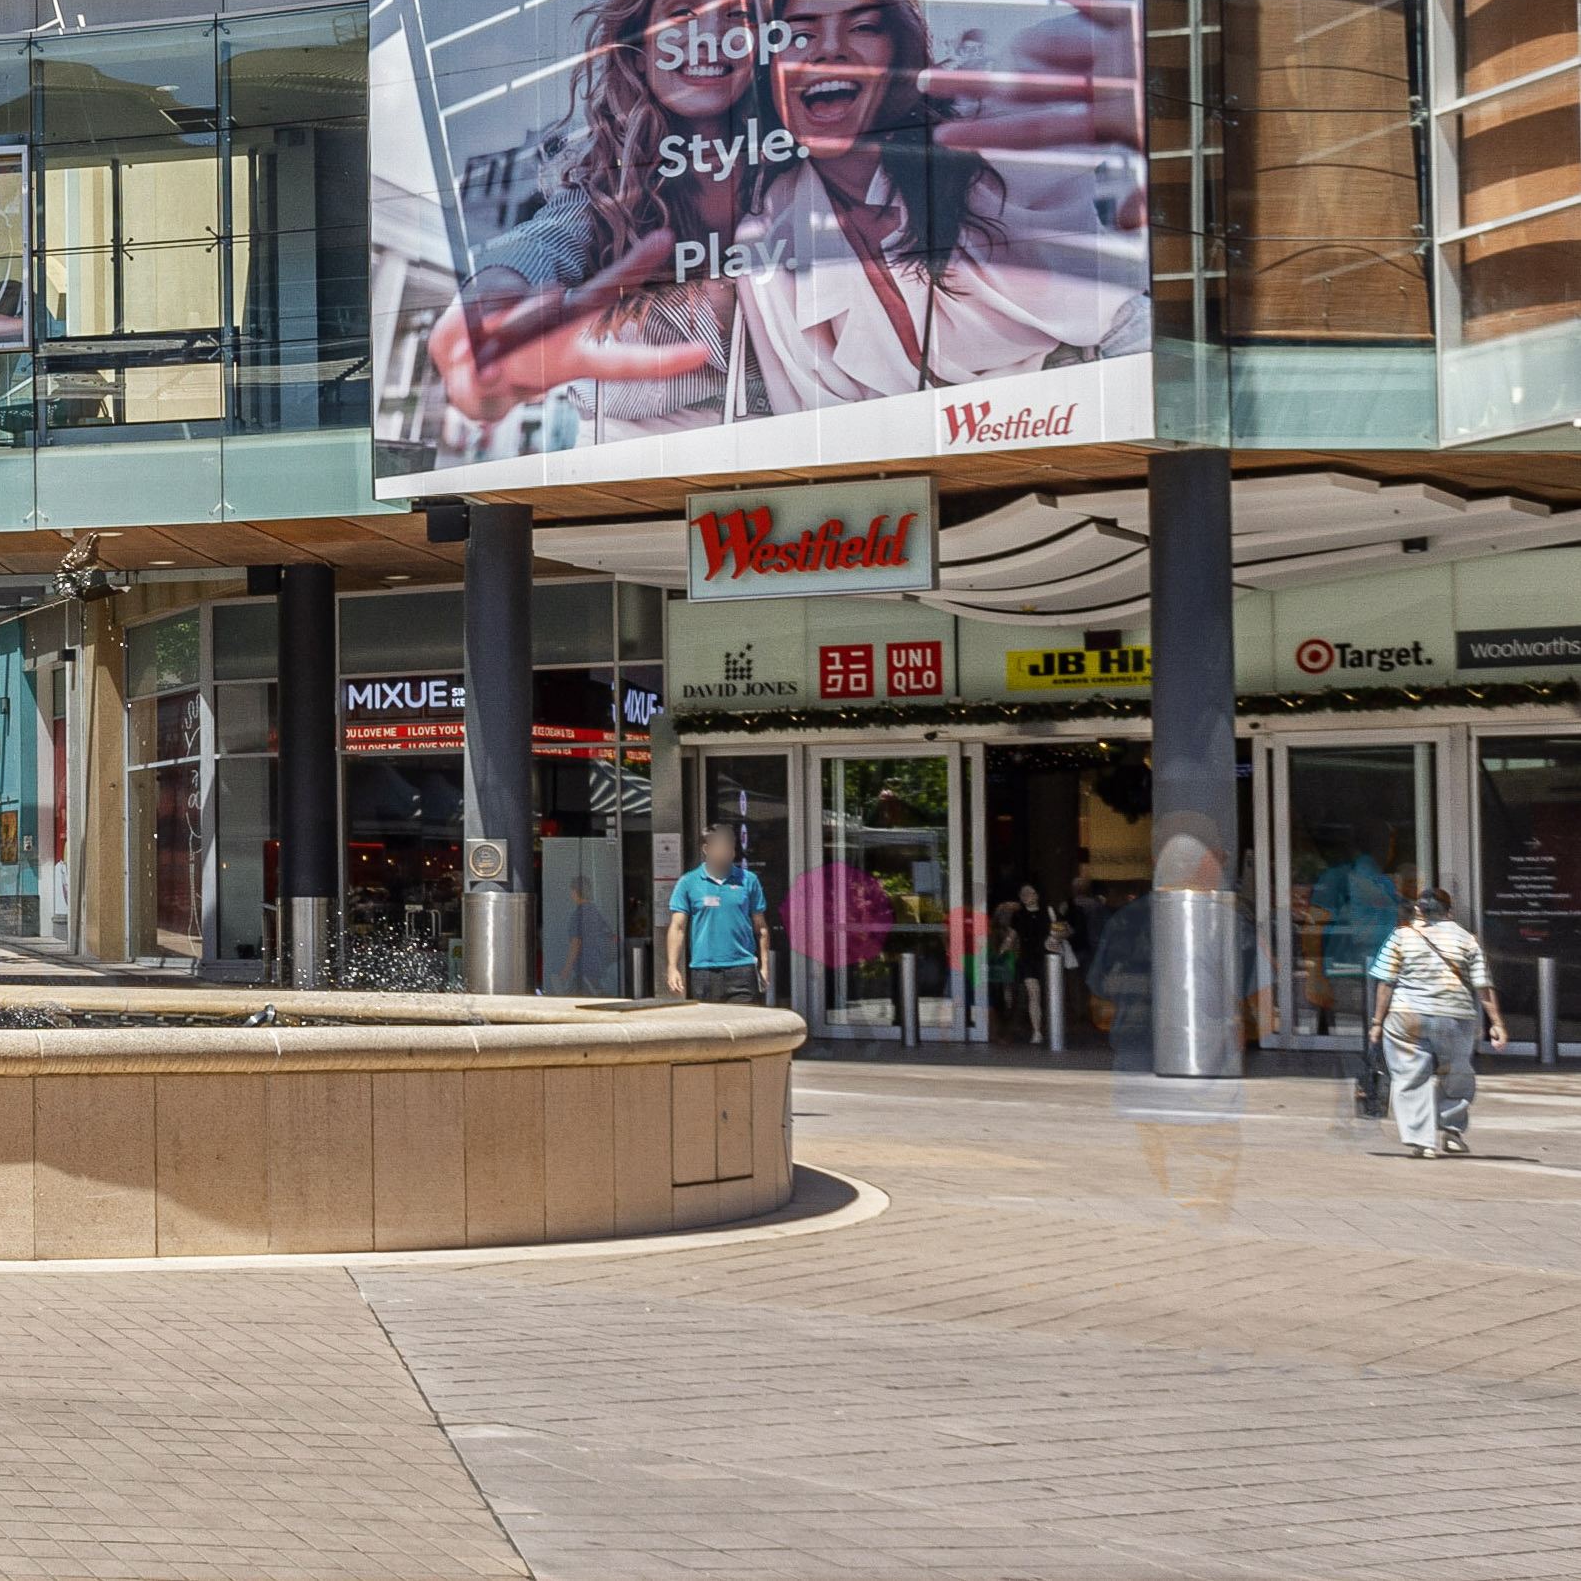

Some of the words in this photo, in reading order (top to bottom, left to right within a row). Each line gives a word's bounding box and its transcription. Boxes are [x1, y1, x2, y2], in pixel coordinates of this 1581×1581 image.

[655, 19, 807, 70] Shop.
[657, 118, 810, 182] Style.
[675, 232, 798, 285] Play.
[941, 400, 1078, 446] Westfield
[690, 506, 918, 581] Westfield
[892, 648, 932, 668] UNI
[1028, 652, 1085, 676] JB
[348, 680, 448, 710] MIXUE
[683, 683, 737, 698] DAVID
[742, 681, 798, 696] JONES
[893, 670, 936, 693] QLO
[358, 728, 381, 737] LOVE
[383, 727, 397, 736] ME
[412, 726, 436, 736] LOVE
[438, 725, 458, 735] YOU
